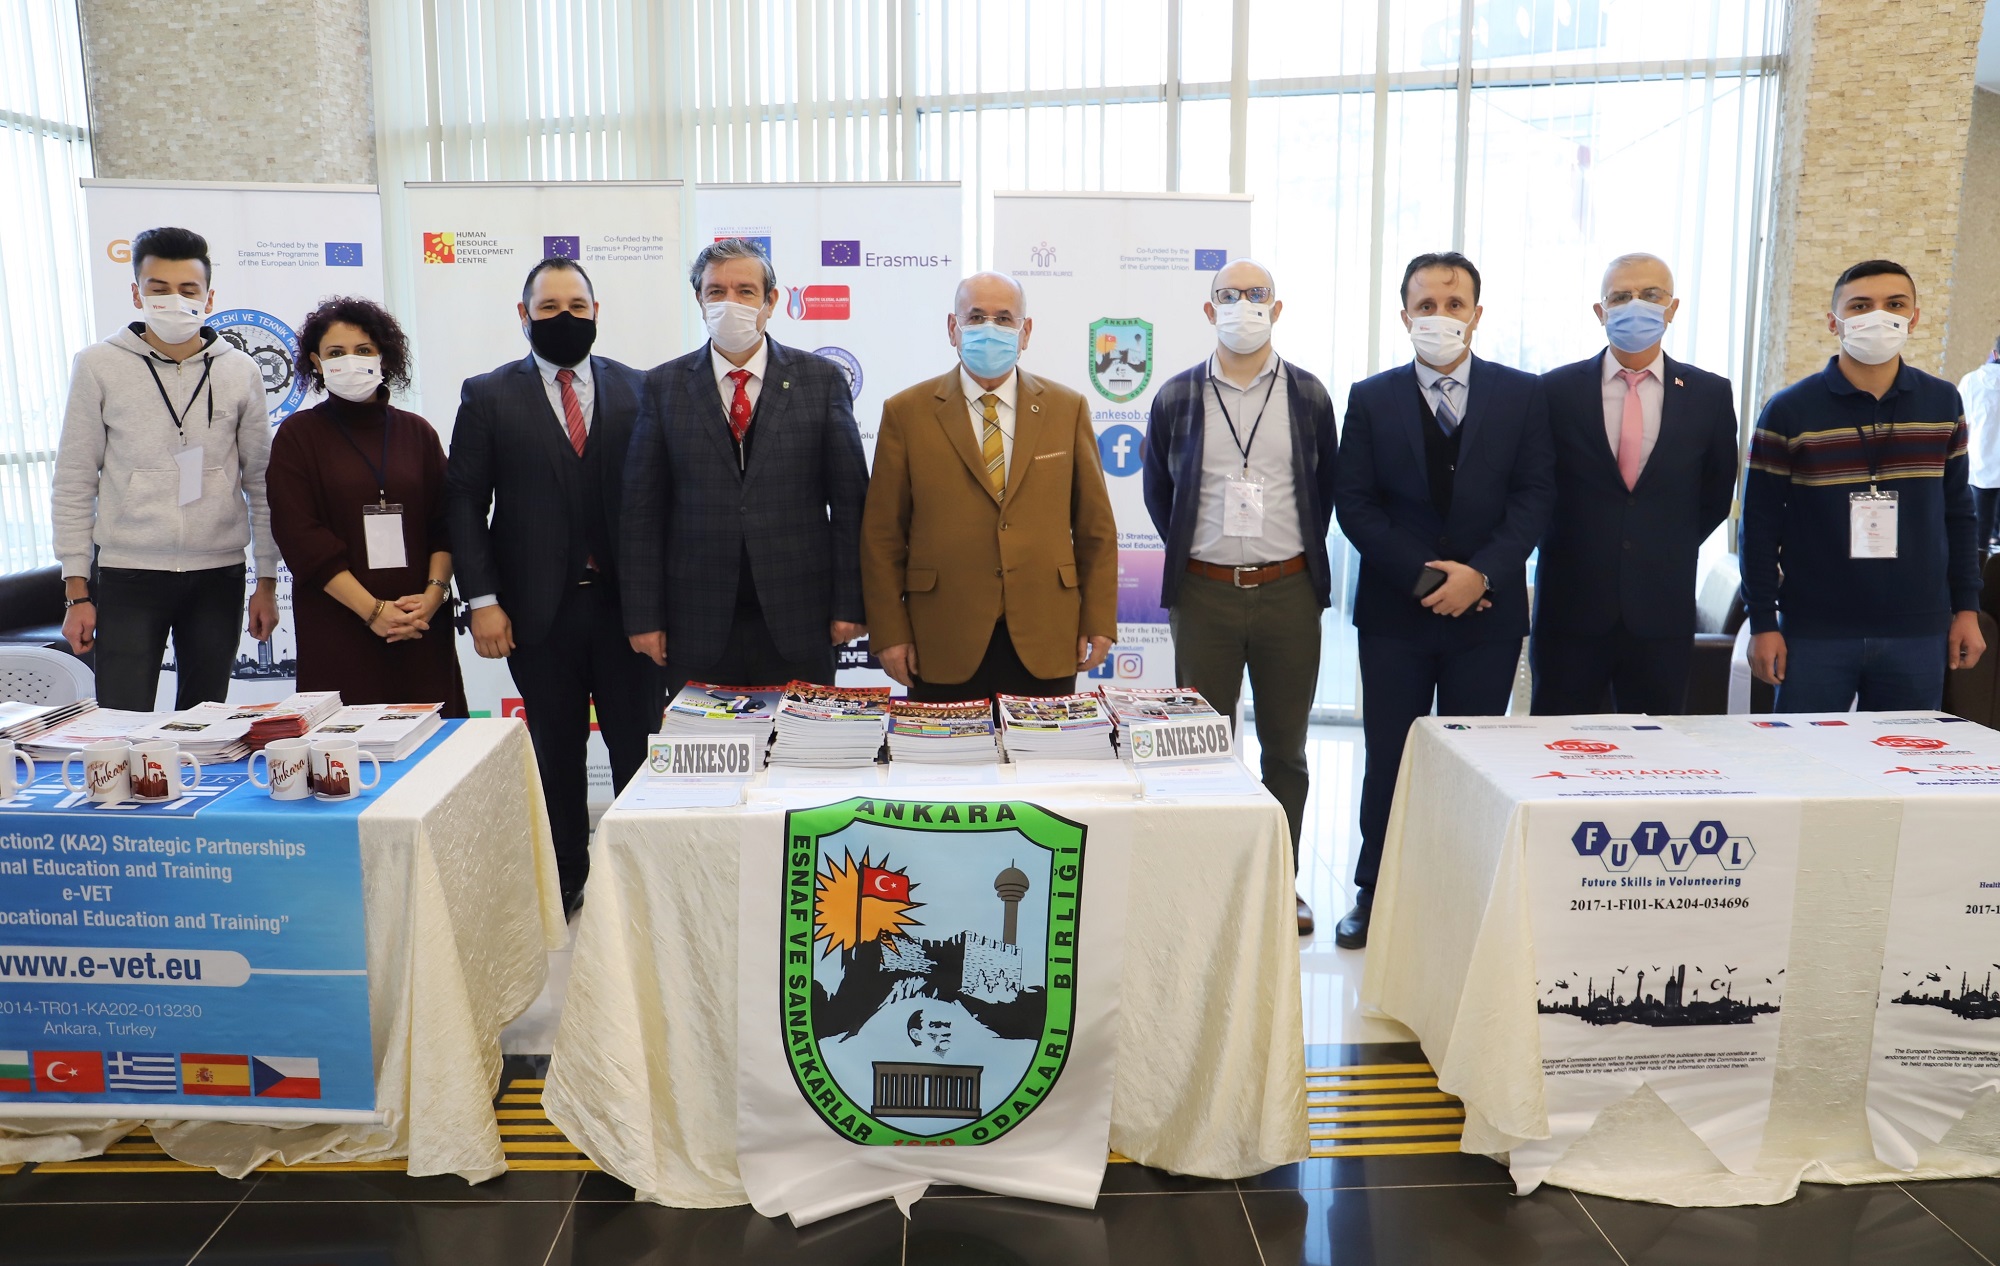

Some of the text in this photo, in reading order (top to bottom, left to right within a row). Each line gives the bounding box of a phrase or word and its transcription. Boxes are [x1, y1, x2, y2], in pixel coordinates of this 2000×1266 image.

[256, 241, 296, 249] Co-funded
[298, 242, 307, 250] by
[277, 251, 319, 260] Programme
[623, 245, 664, 253] Programme
[260, 260, 296, 269] European
[608, 254, 642, 262] European
[866, 252, 952, 268] Erasmus+
[242, 313, 290, 338] VE TEKNİK
[1155, 724, 1229, 757] ANKESOB
[672, 742, 750, 774] ANKESOB
[88, 760, 128, 797] Ankara
[270, 758, 305, 794] Ankara
[855, 800, 1017, 824] ANKARA
[0, 833, 306, 860] ction2 (KA2) Strategic Partnerships
[1586, 826, 1742, 866] FUTVOL
[0, 858, 232, 882] nal Education and Training
[1581, 876, 1742, 887] Future Skills in Volunteering
[62, 885, 113, 902] e-VET
[1570, 897, 1750, 911] 2017-1-FI01-KA204-034696
[0, 908, 78, 926] ocational
[84, 910, 169, 928] Education
[174, 912, 206, 929] and
[788, 834, 1080, 1142] ESNAF VE SANATKARLAR ODALARI BİRLİĞİ
[44, 1022, 157, 1038] Ankara, Turkey
